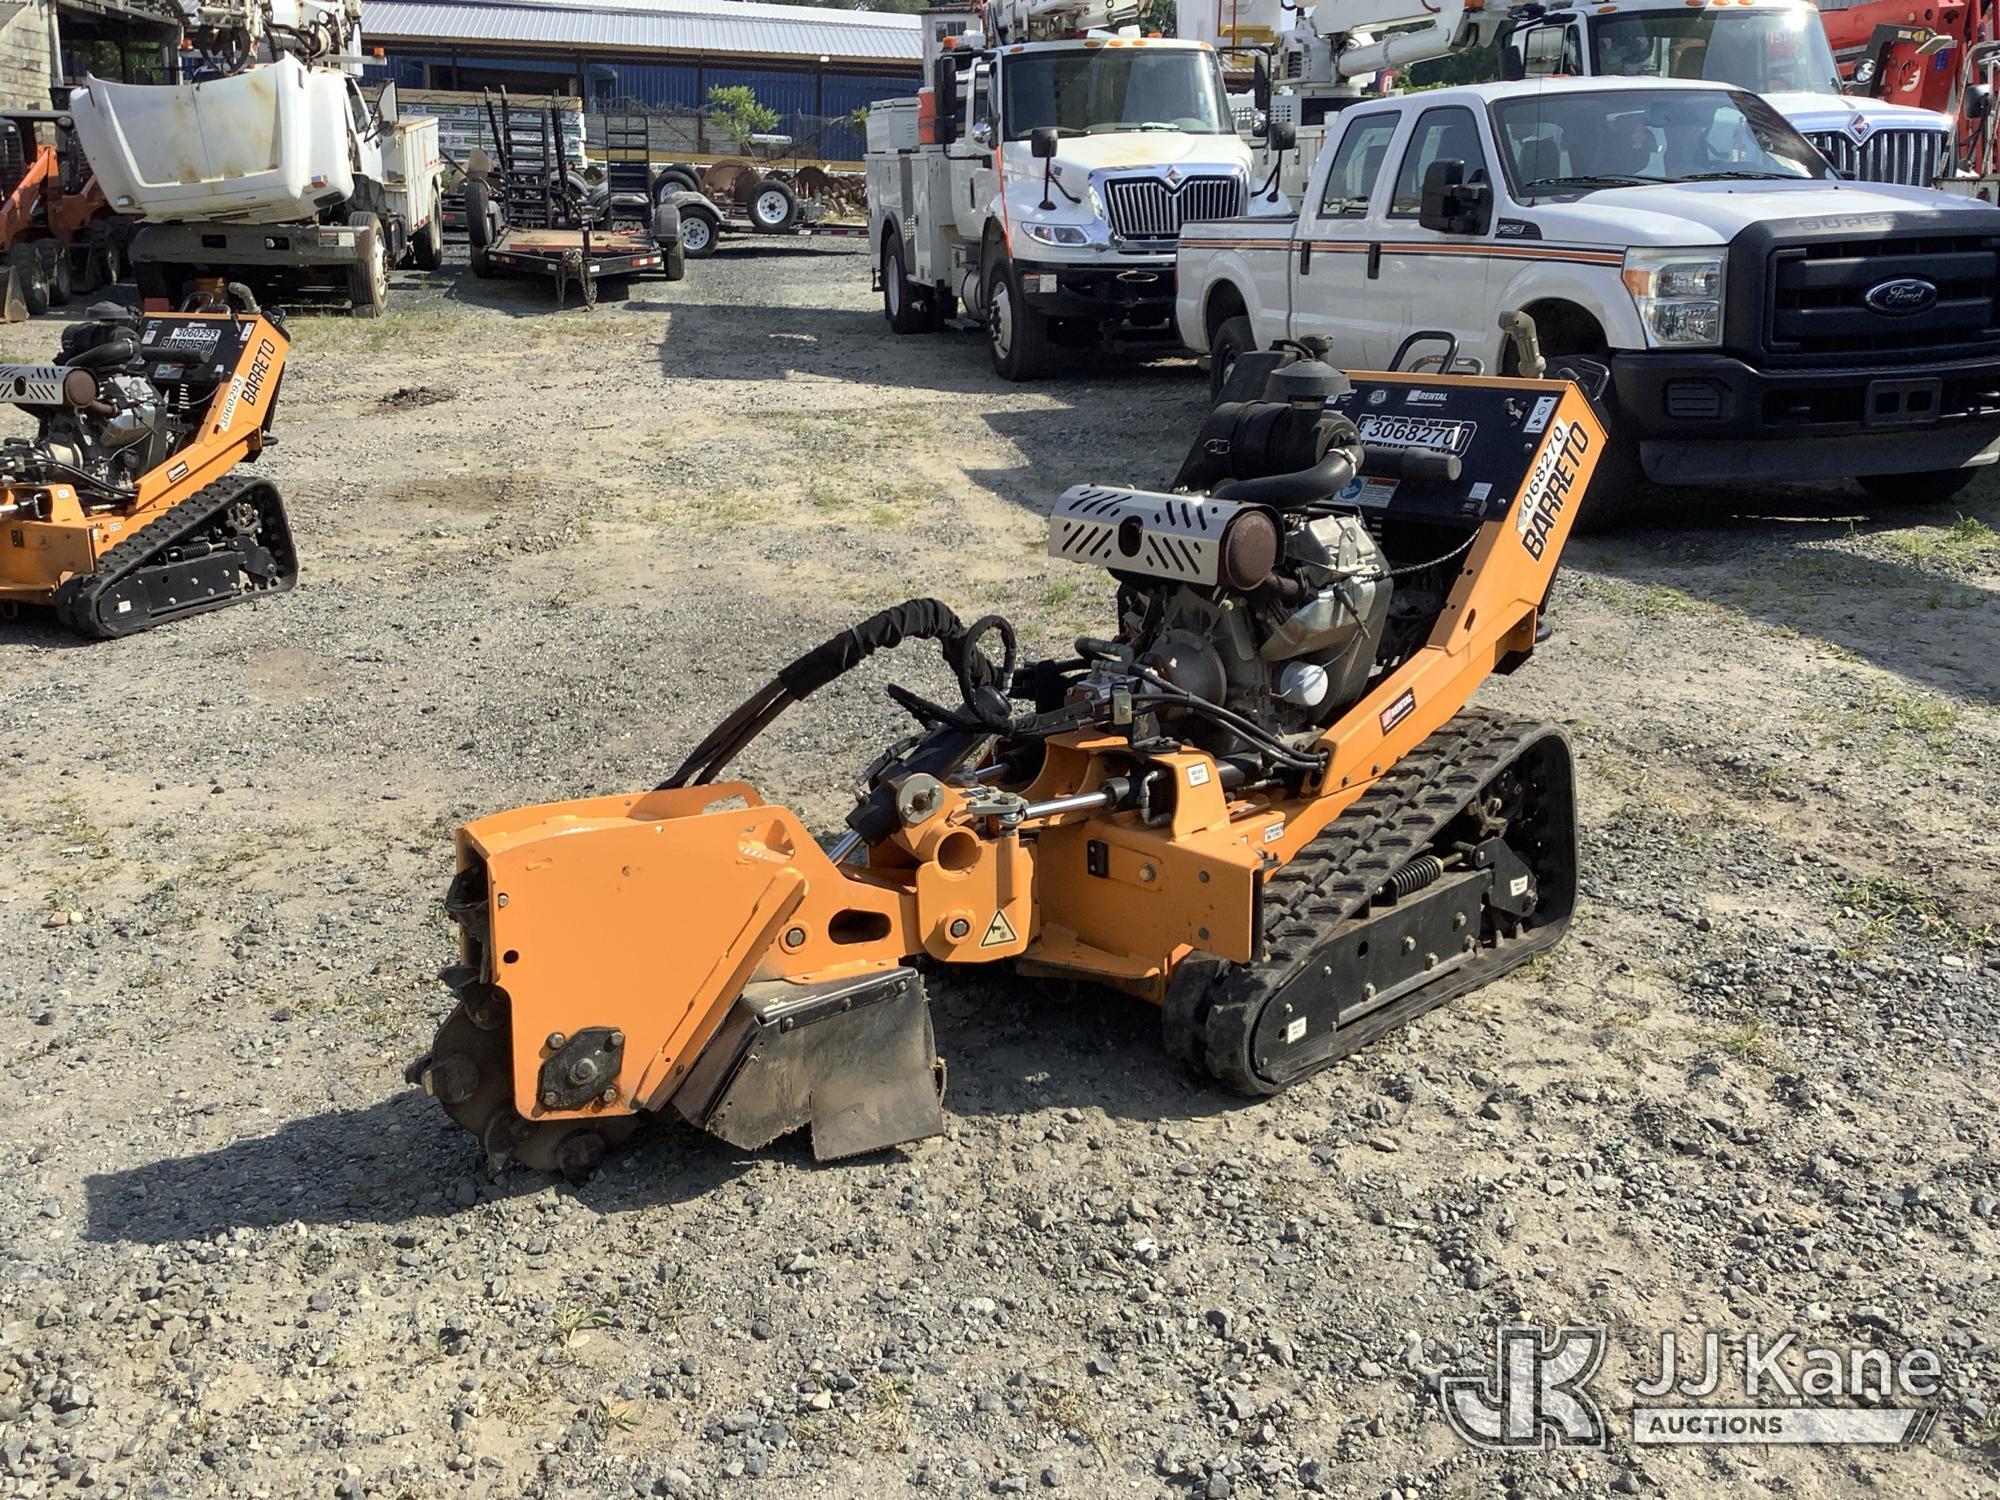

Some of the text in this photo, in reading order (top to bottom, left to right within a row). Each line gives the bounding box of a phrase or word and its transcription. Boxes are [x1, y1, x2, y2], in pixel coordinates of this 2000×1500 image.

[1885, 284, 1924, 304] Ford
[175, 329, 217, 339] 3060293
[241, 338, 276, 406] BARRETO
[221, 377, 242, 427] 3060293
[1418, 392, 1448, 401] RENTAL
[1368, 421, 1456, 446] 3068270
[1522, 425, 1564, 518] 068270
[1521, 420, 1589, 563] BARRETO
